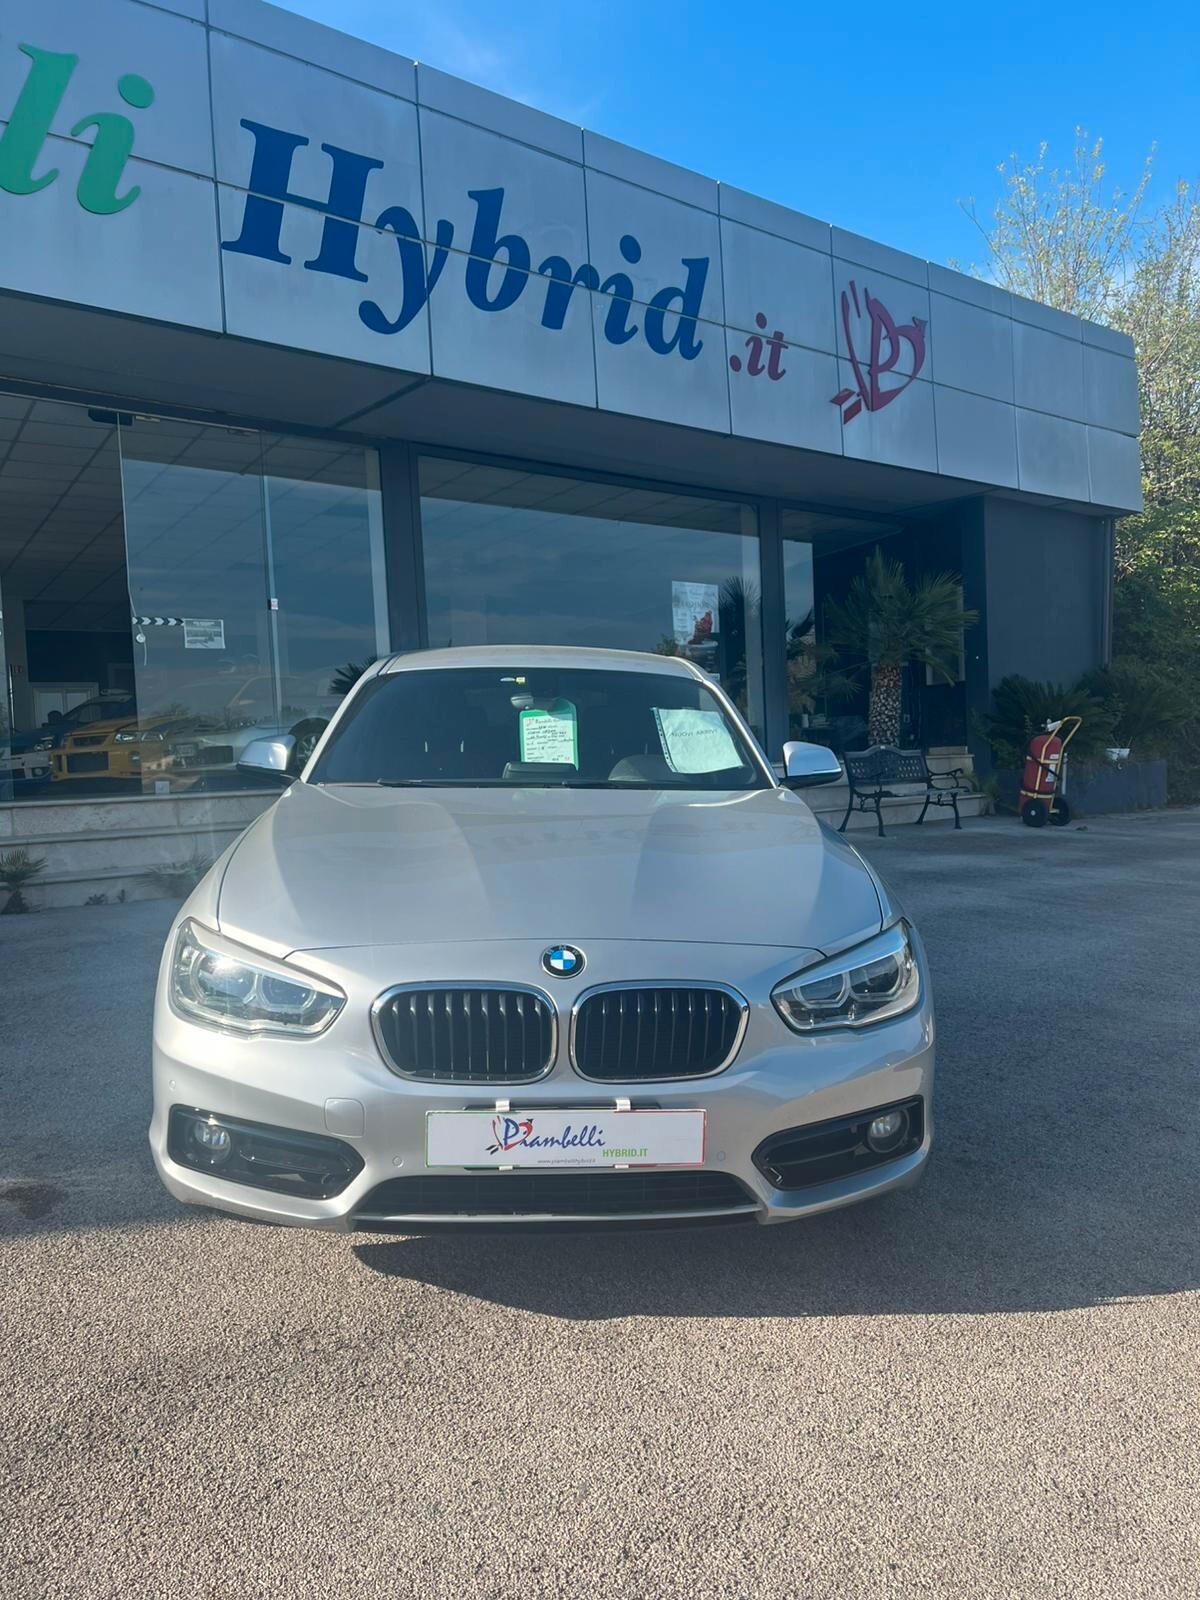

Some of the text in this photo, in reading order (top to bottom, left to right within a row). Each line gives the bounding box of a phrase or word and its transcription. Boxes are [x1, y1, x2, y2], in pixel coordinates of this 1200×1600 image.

[221, 118, 710, 361] Hybrid
[501, 1117, 606, 1150] Piambelli
[602, 1148, 649, 1158] HYBRID.IT
